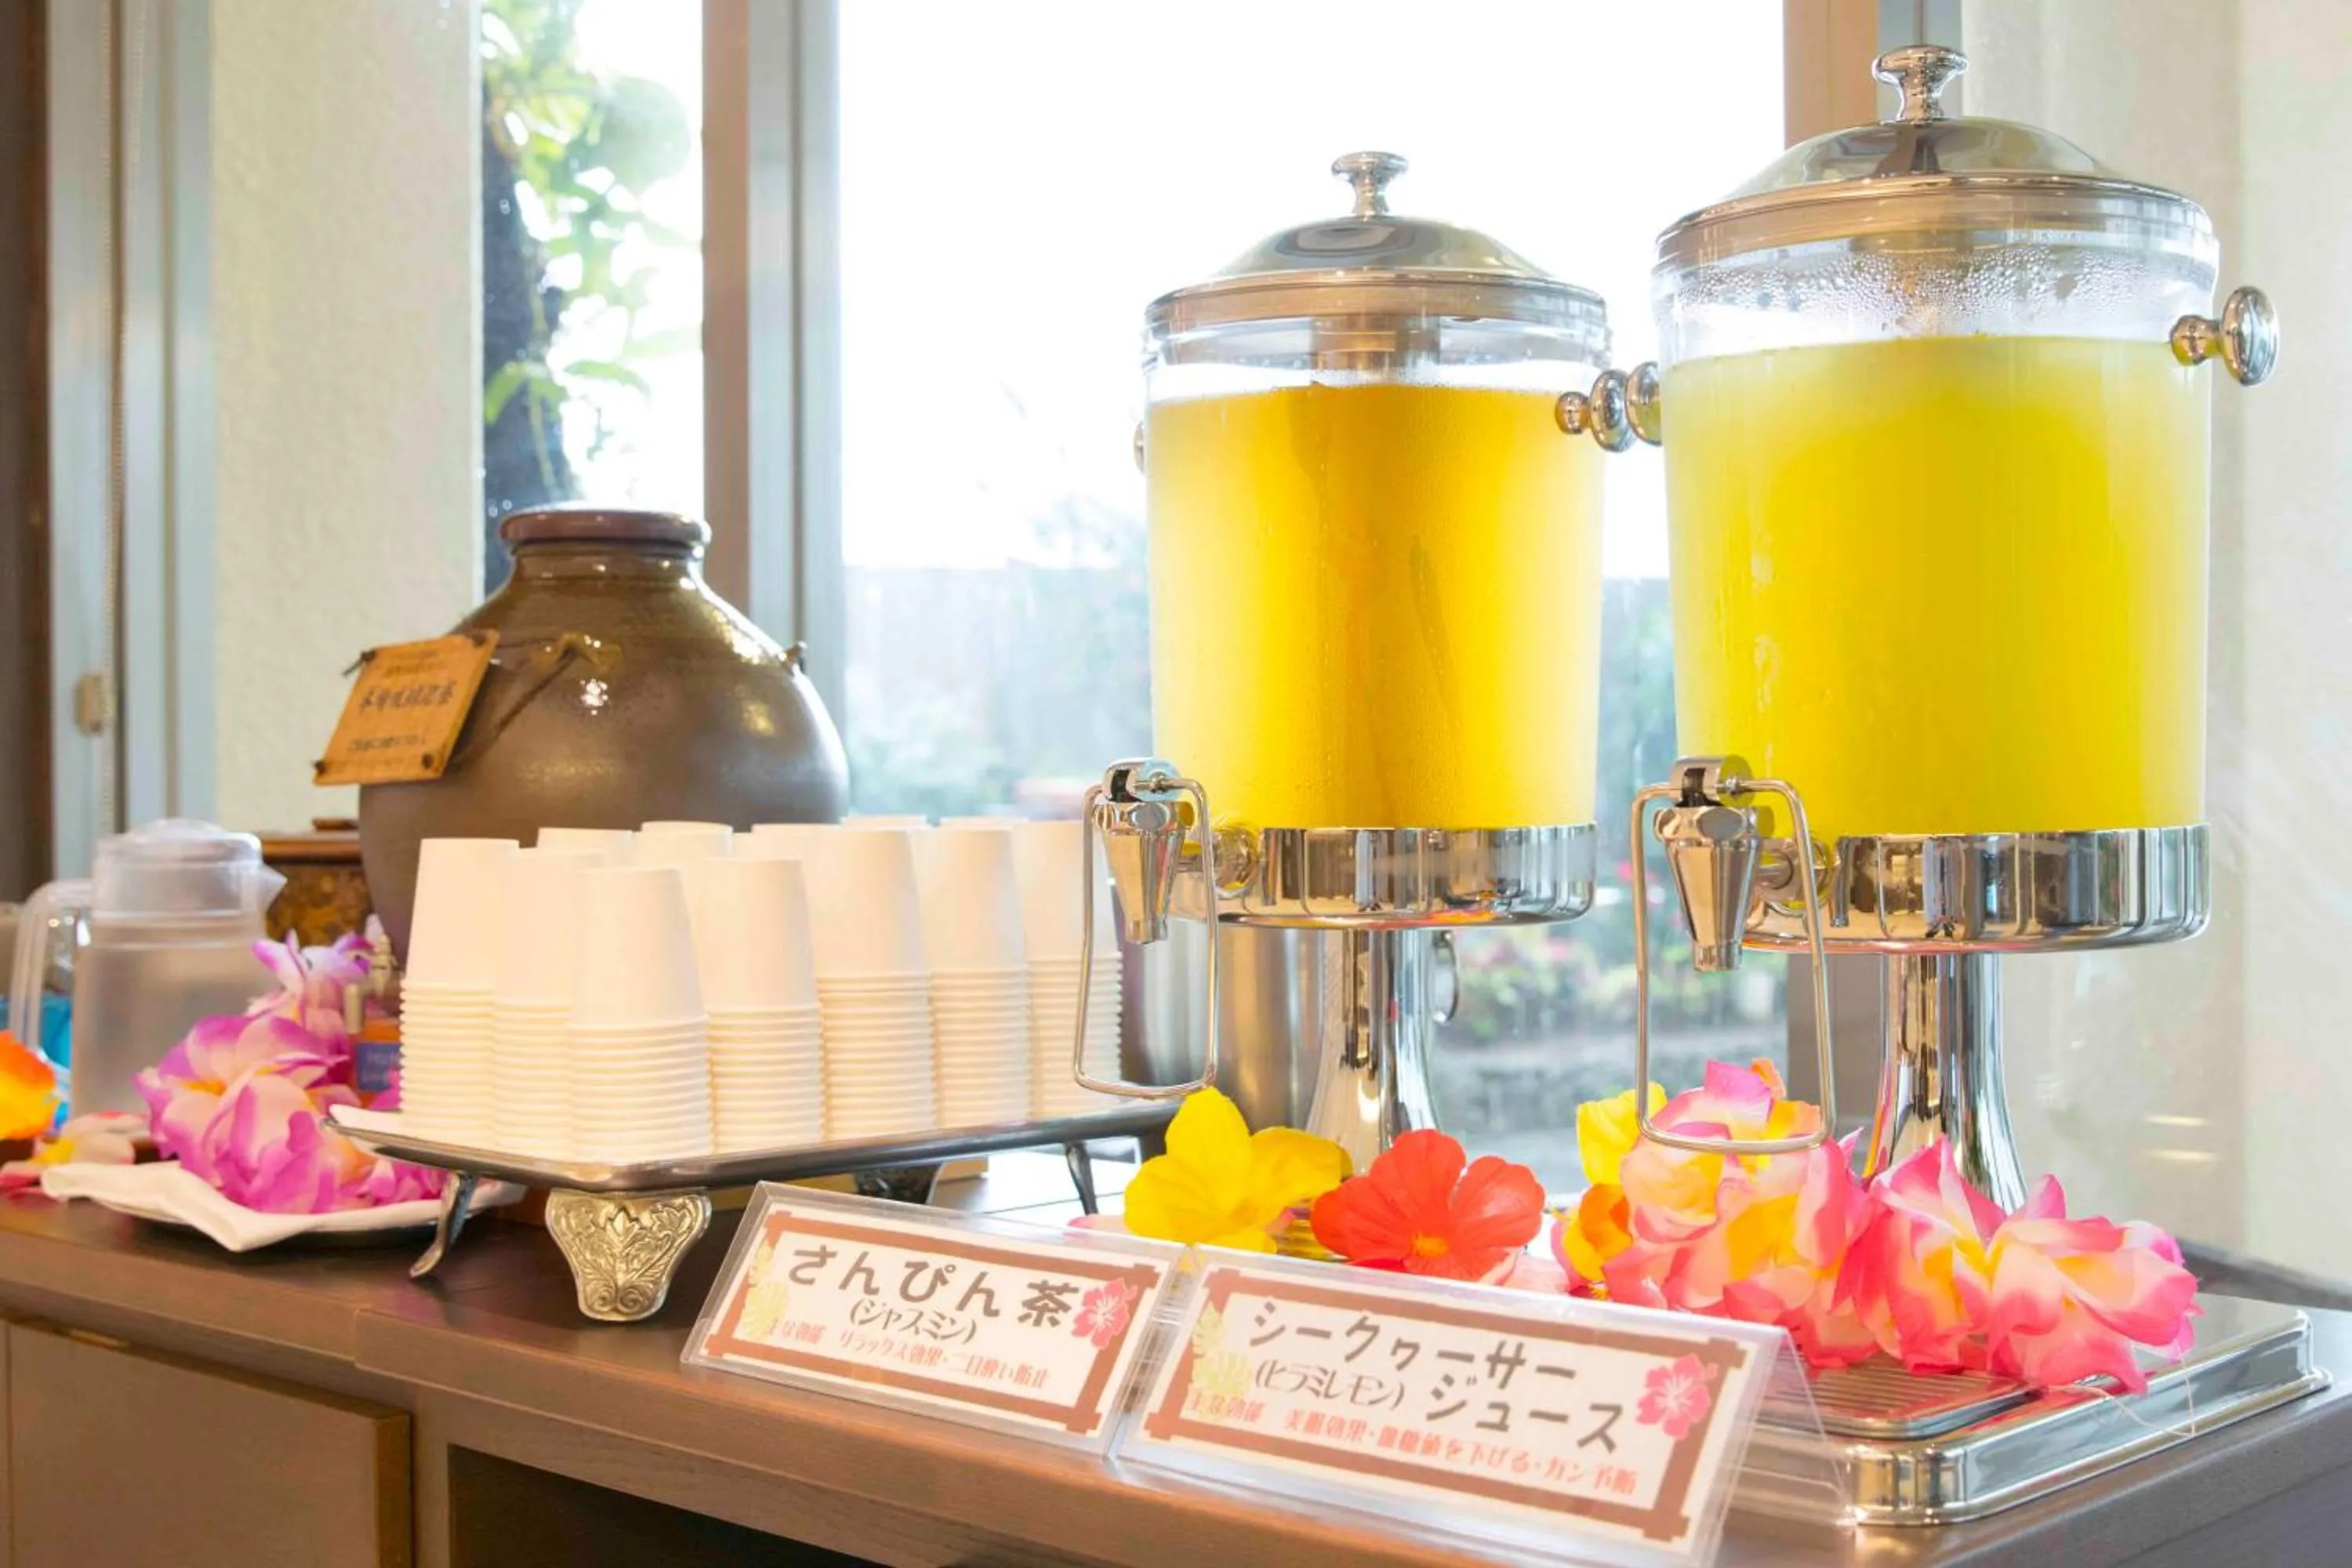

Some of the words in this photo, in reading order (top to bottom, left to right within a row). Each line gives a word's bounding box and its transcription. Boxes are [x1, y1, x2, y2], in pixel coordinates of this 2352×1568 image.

[788, 1244, 1080, 1327] さんぴん茶
[849, 1298, 977, 1345] (ジャスミン)
[1249, 1301, 1577, 1389] シークヮーサー
[1254, 1359, 1406, 1410] (ヒラミレモン)
[1426, 1374, 1624, 1453] ジュース
